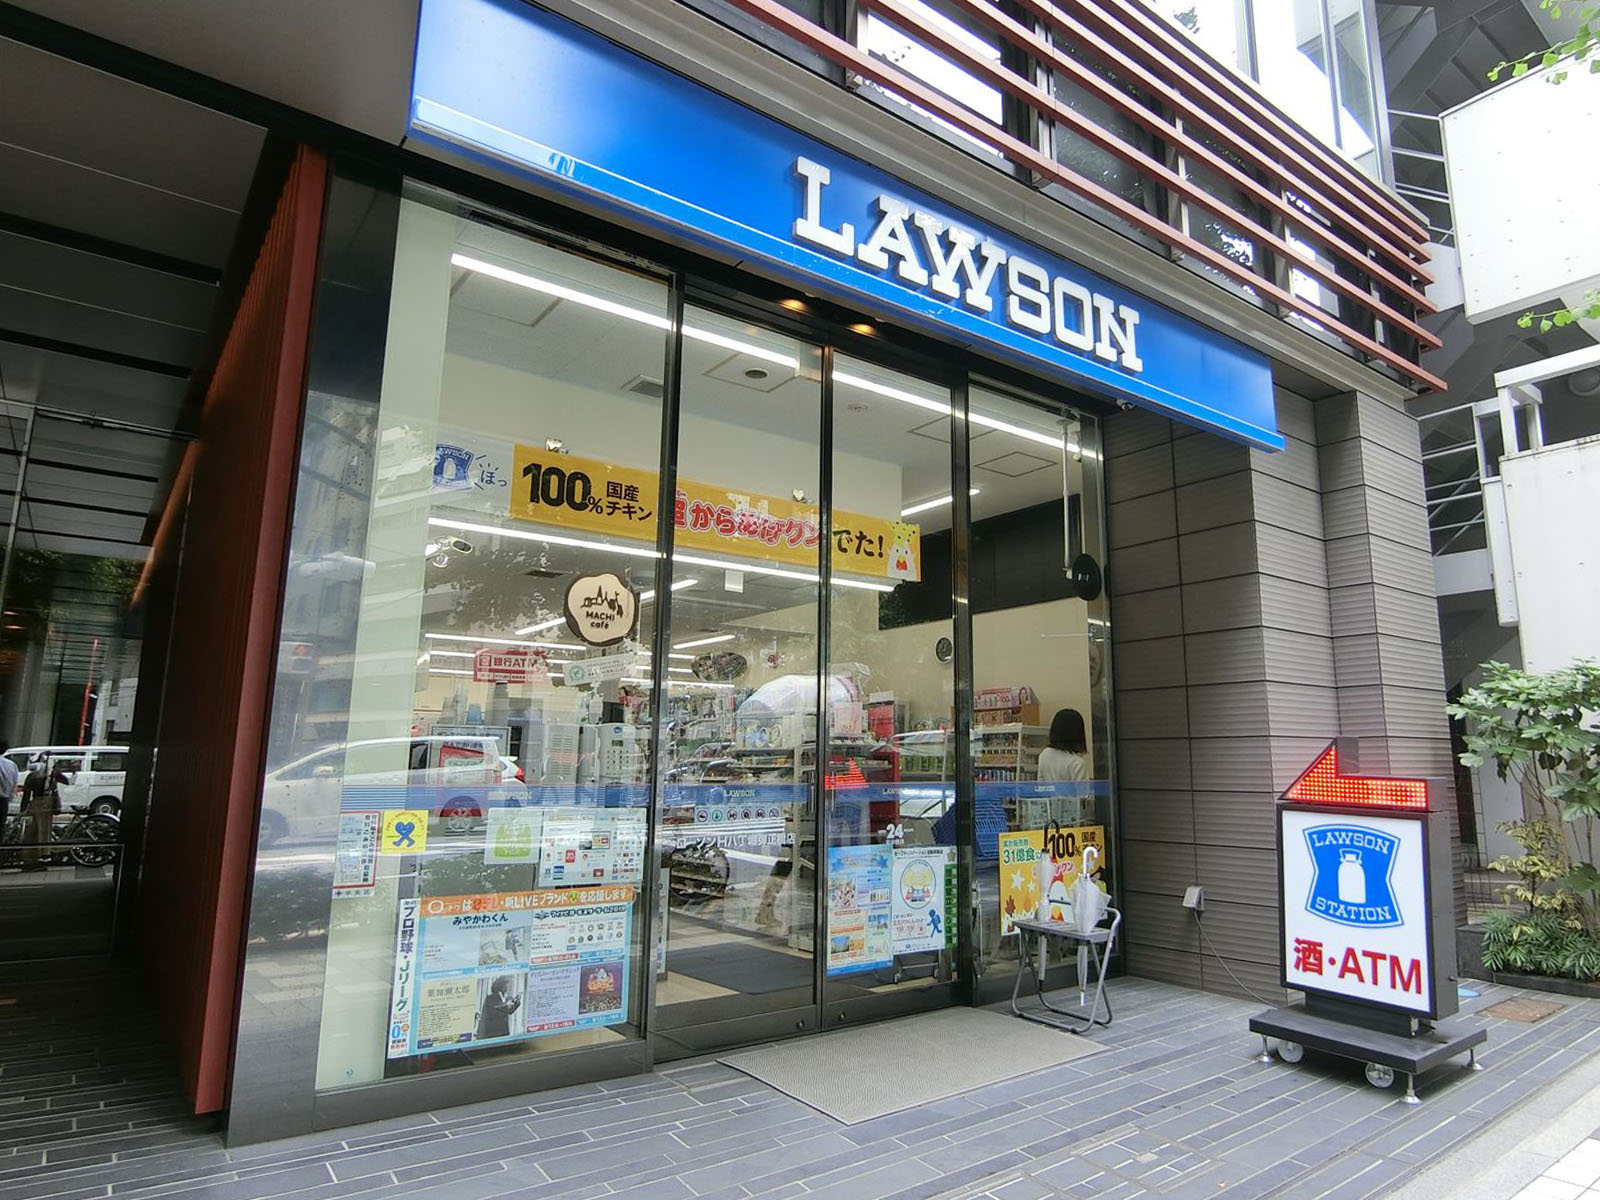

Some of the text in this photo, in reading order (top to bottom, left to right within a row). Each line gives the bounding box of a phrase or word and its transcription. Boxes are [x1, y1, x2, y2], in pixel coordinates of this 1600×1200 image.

[794, 156, 1144, 373] LAWSON
[480, 468, 507, 487] ほっ
[523, 463, 603, 514] 100%
[606, 481, 640, 503] 国産
[606, 500, 653, 522] チキン
[586, 610, 616, 622] MACHI
[591, 620, 610, 630] café
[886, 823, 904, 839] 24
[1081, 831, 1097, 843] 国産
[1312, 832, 1391, 855] LAWSON
[1315, 896, 1391, 921] STATION
[452, 912, 509, 926] みやかわくん
